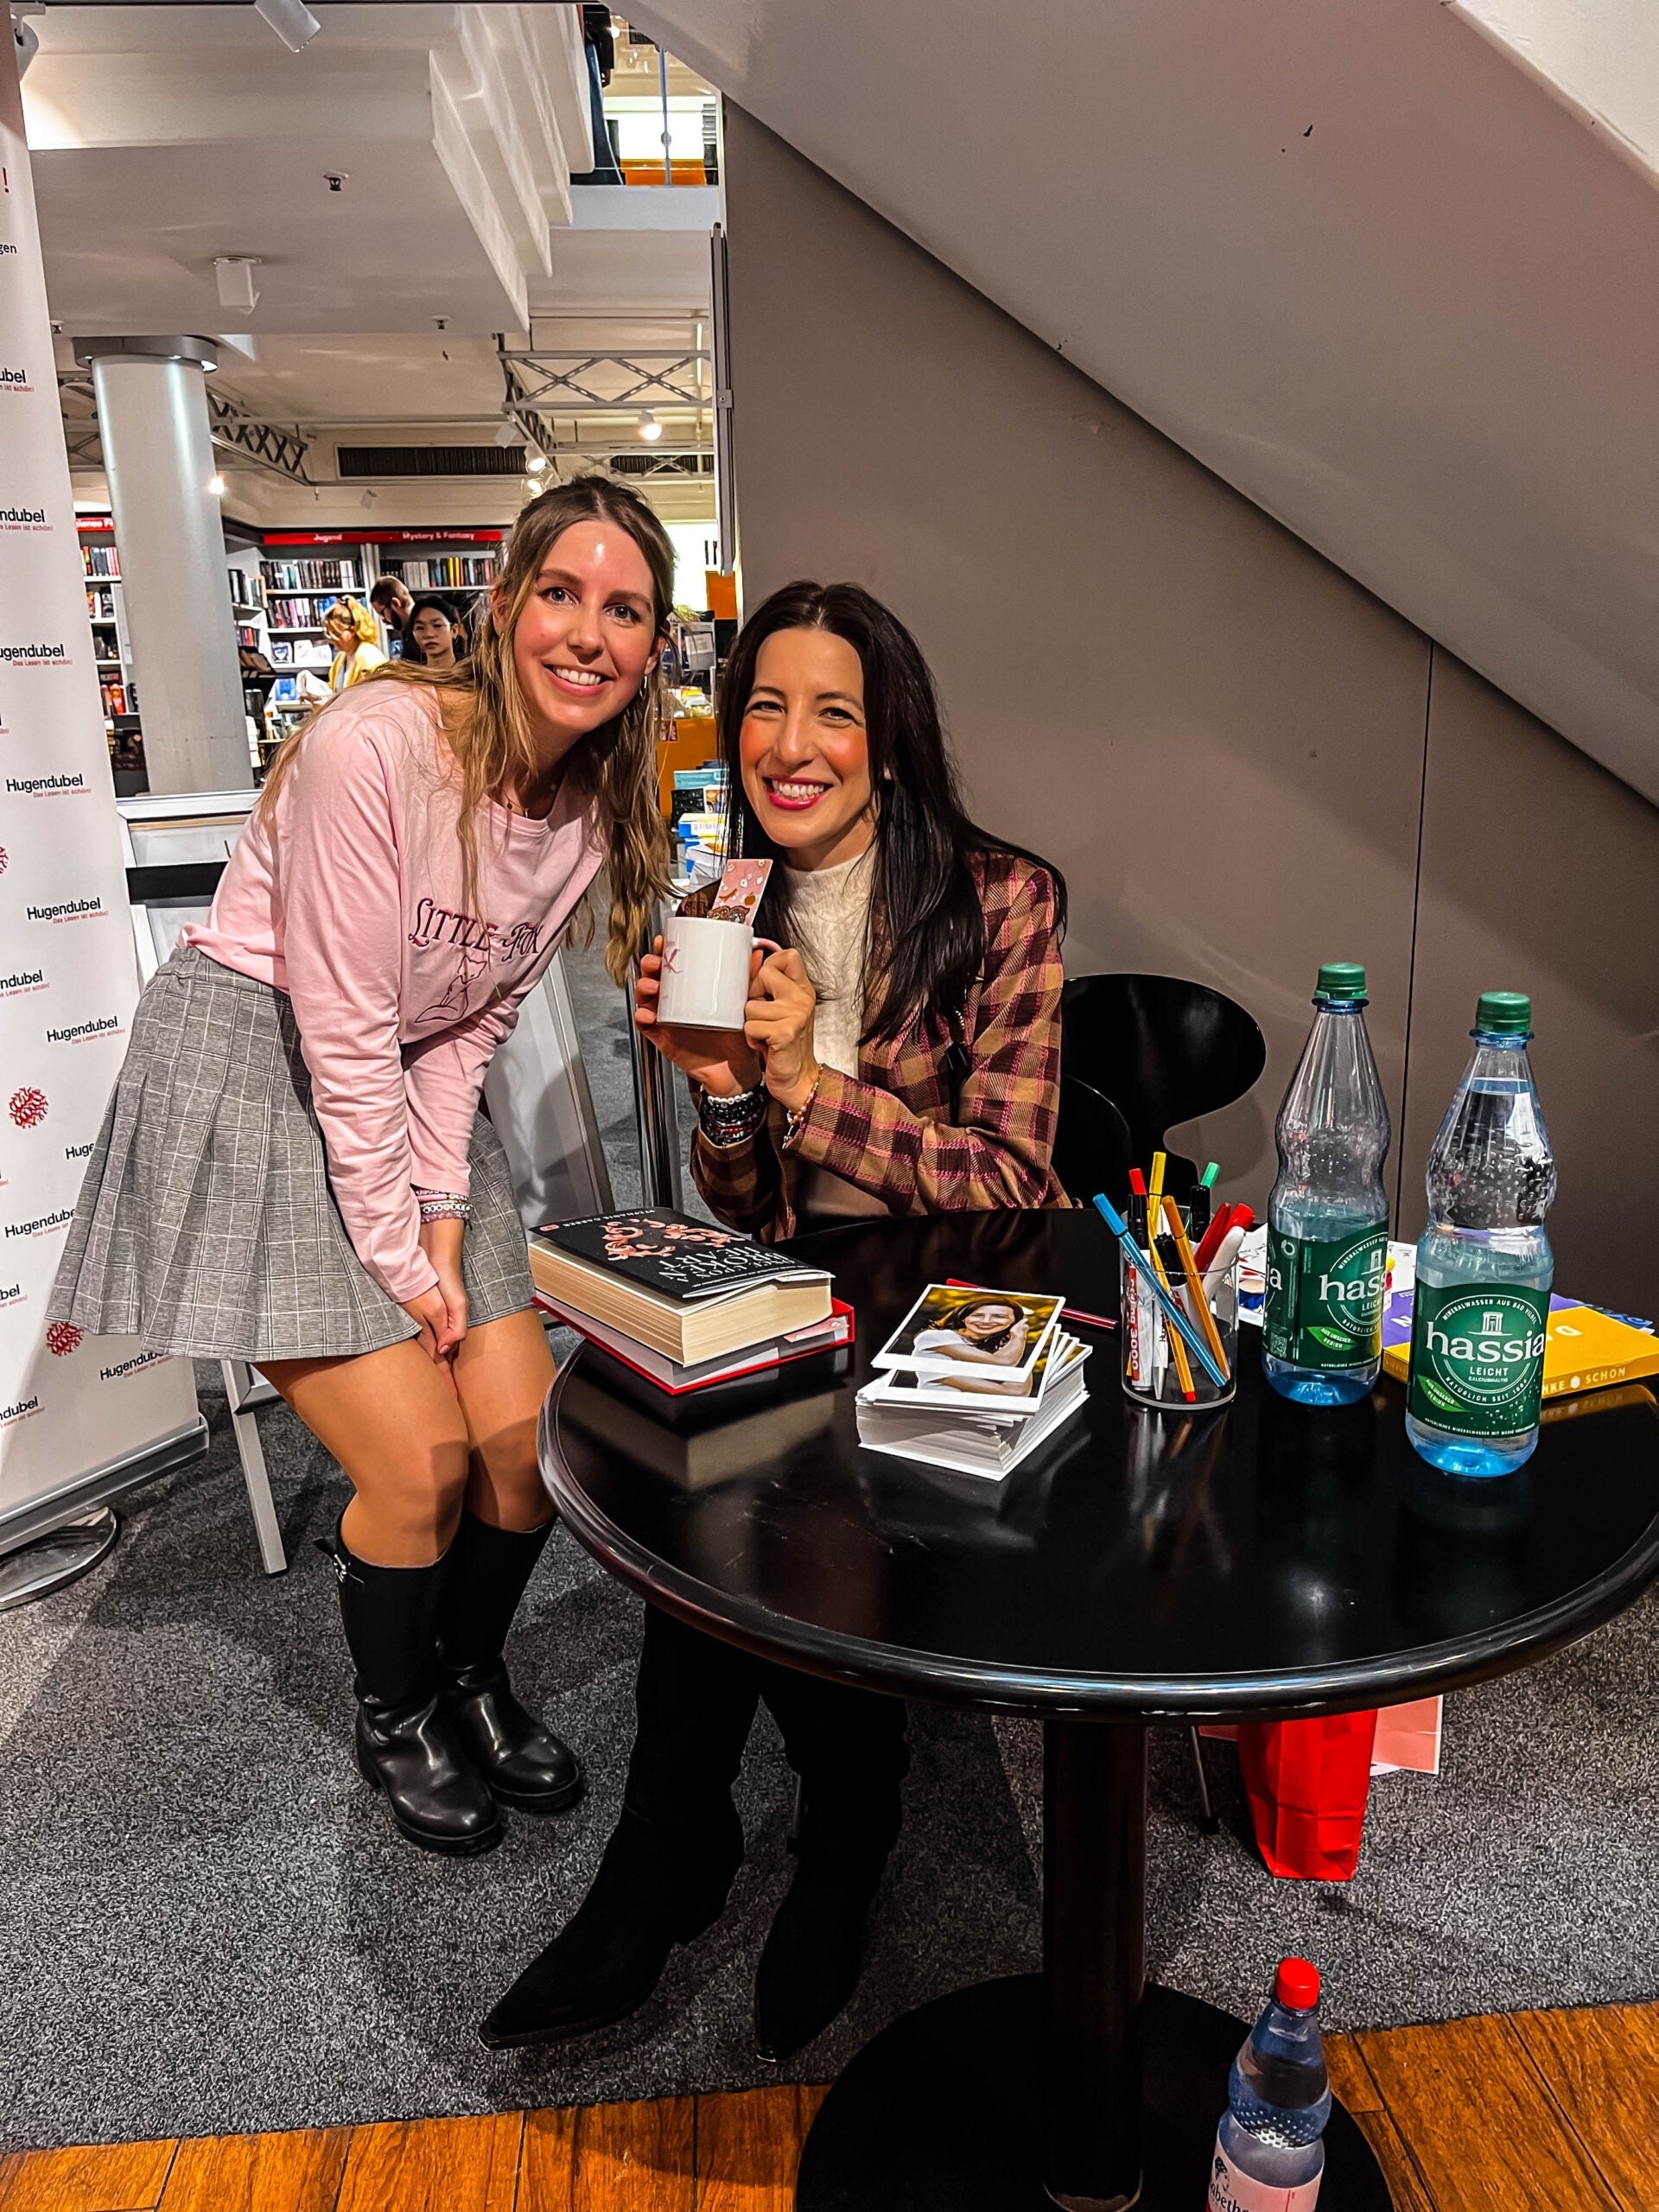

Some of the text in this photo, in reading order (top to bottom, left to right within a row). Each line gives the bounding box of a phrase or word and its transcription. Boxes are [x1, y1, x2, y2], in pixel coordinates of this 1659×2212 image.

[403, 531, 434, 541] Mystery
[443, 531, 475, 541] Fantasy
[6, 773, 83, 793] Hugendubel
[27, 897, 101, 920] Hugendubel
[47, 1016, 118, 1042] Hugendubel
[1442, 1299, 1494, 1320] MINERALWASSER
[1130, 1329, 1139, 1370] 3000
[1426, 1321, 1545, 1363] hassia
[100, 1351, 163, 1381] Hugendub
[1470, 1366, 1510, 1376] LEICHT
[1445, 1376, 1487, 1402] NATÜRLICH
[1491, 1393, 1509, 1402] SEIT
